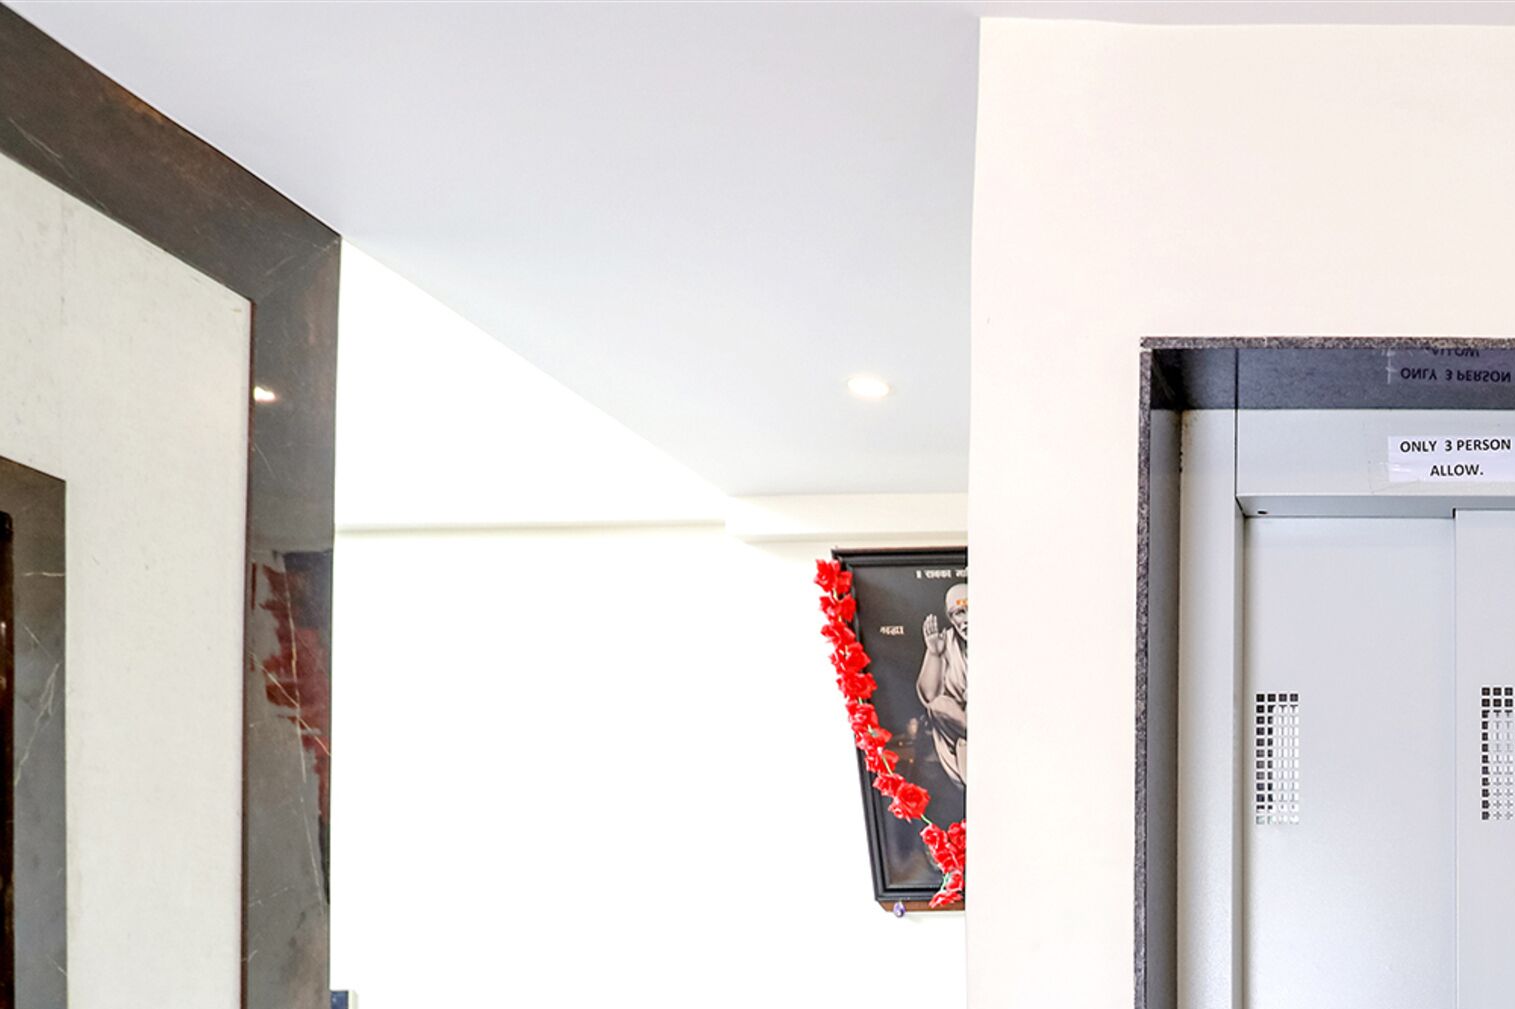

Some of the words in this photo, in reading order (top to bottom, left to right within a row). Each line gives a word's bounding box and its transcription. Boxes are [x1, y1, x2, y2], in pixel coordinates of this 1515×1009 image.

[1400, 440, 1437, 453] ONLY
[1444, 440, 1453, 452] 3
[1457, 439, 1511, 451] PERSON
[1430, 464, 1484, 477] ALLOW.
